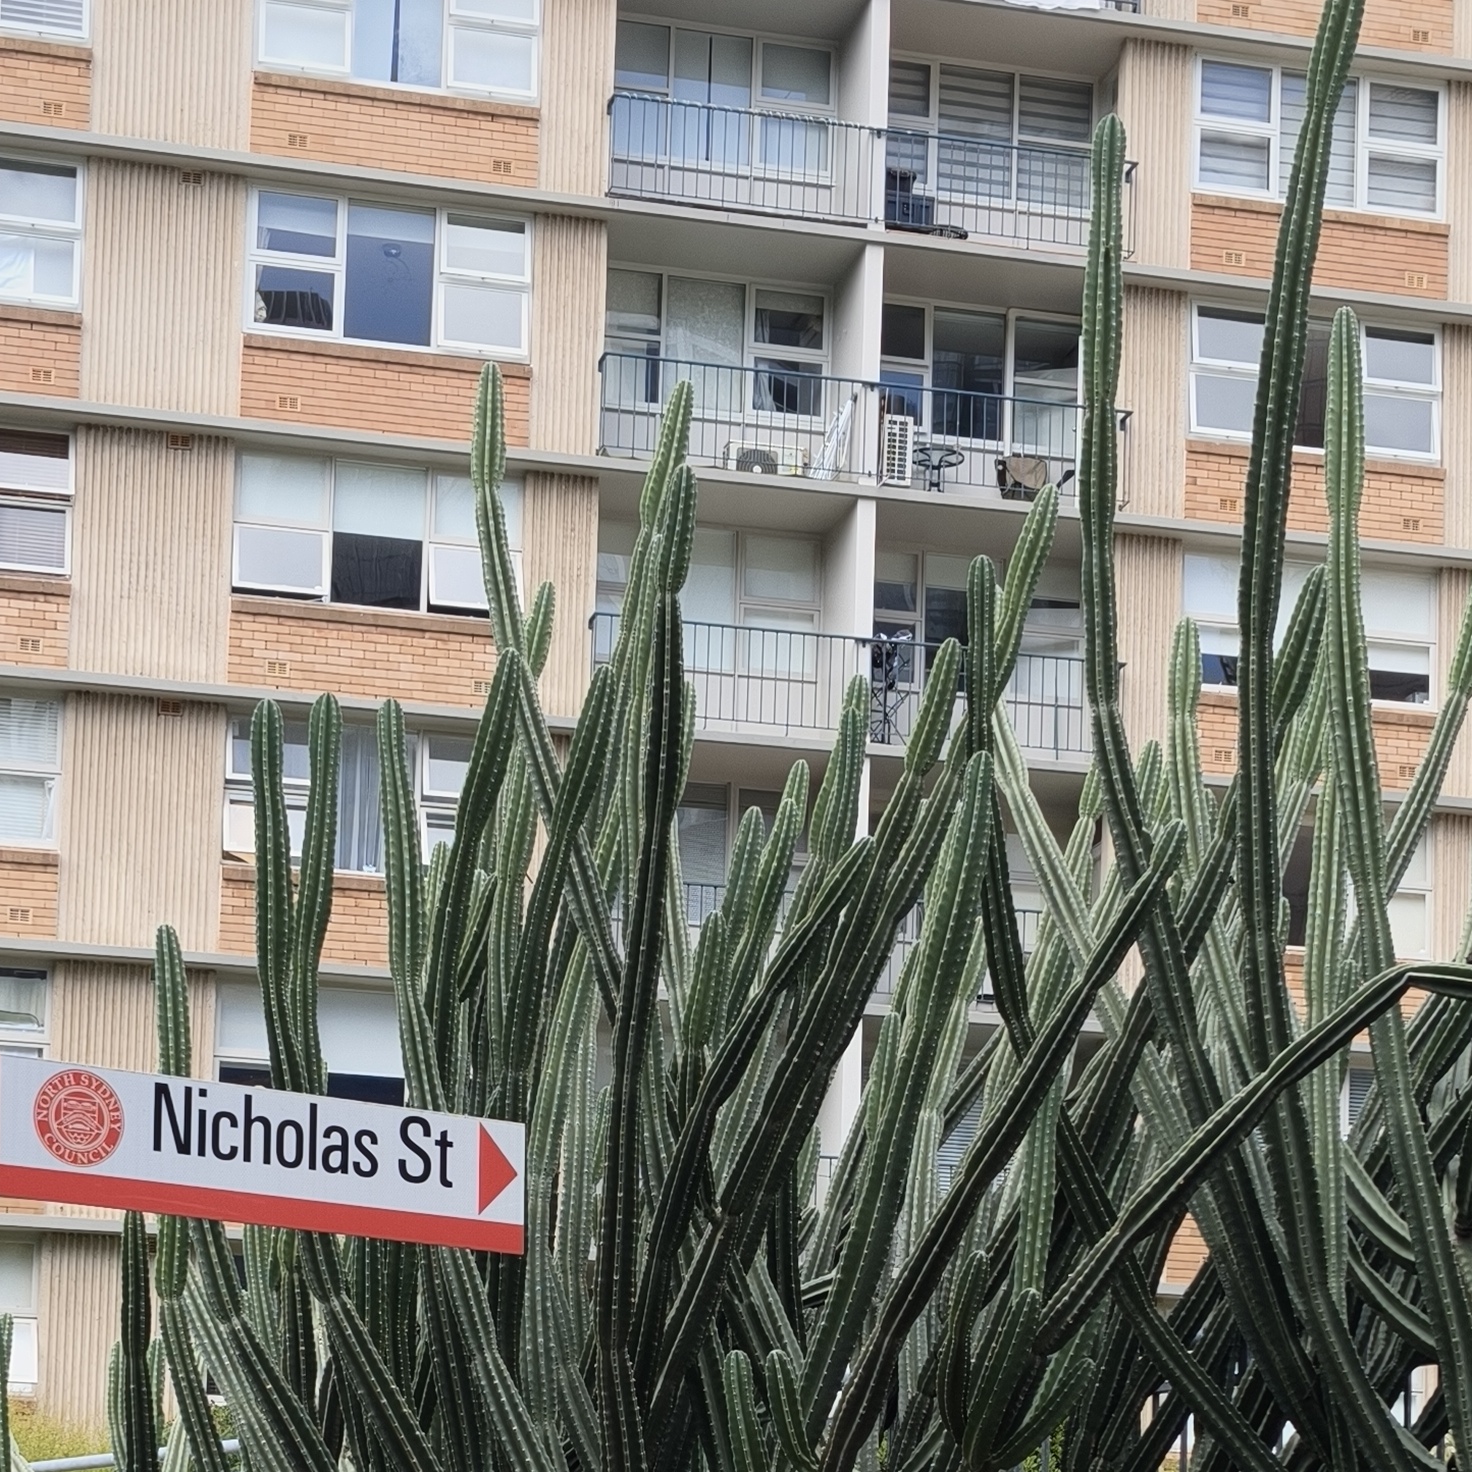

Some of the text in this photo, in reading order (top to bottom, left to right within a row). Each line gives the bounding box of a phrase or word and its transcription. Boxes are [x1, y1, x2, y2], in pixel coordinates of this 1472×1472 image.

[36, 1073, 122, 1132] NORTH SYDNEY
[44, 1132, 114, 1164] COUNCIL
[153, 1082, 454, 1188] Nicholas St
